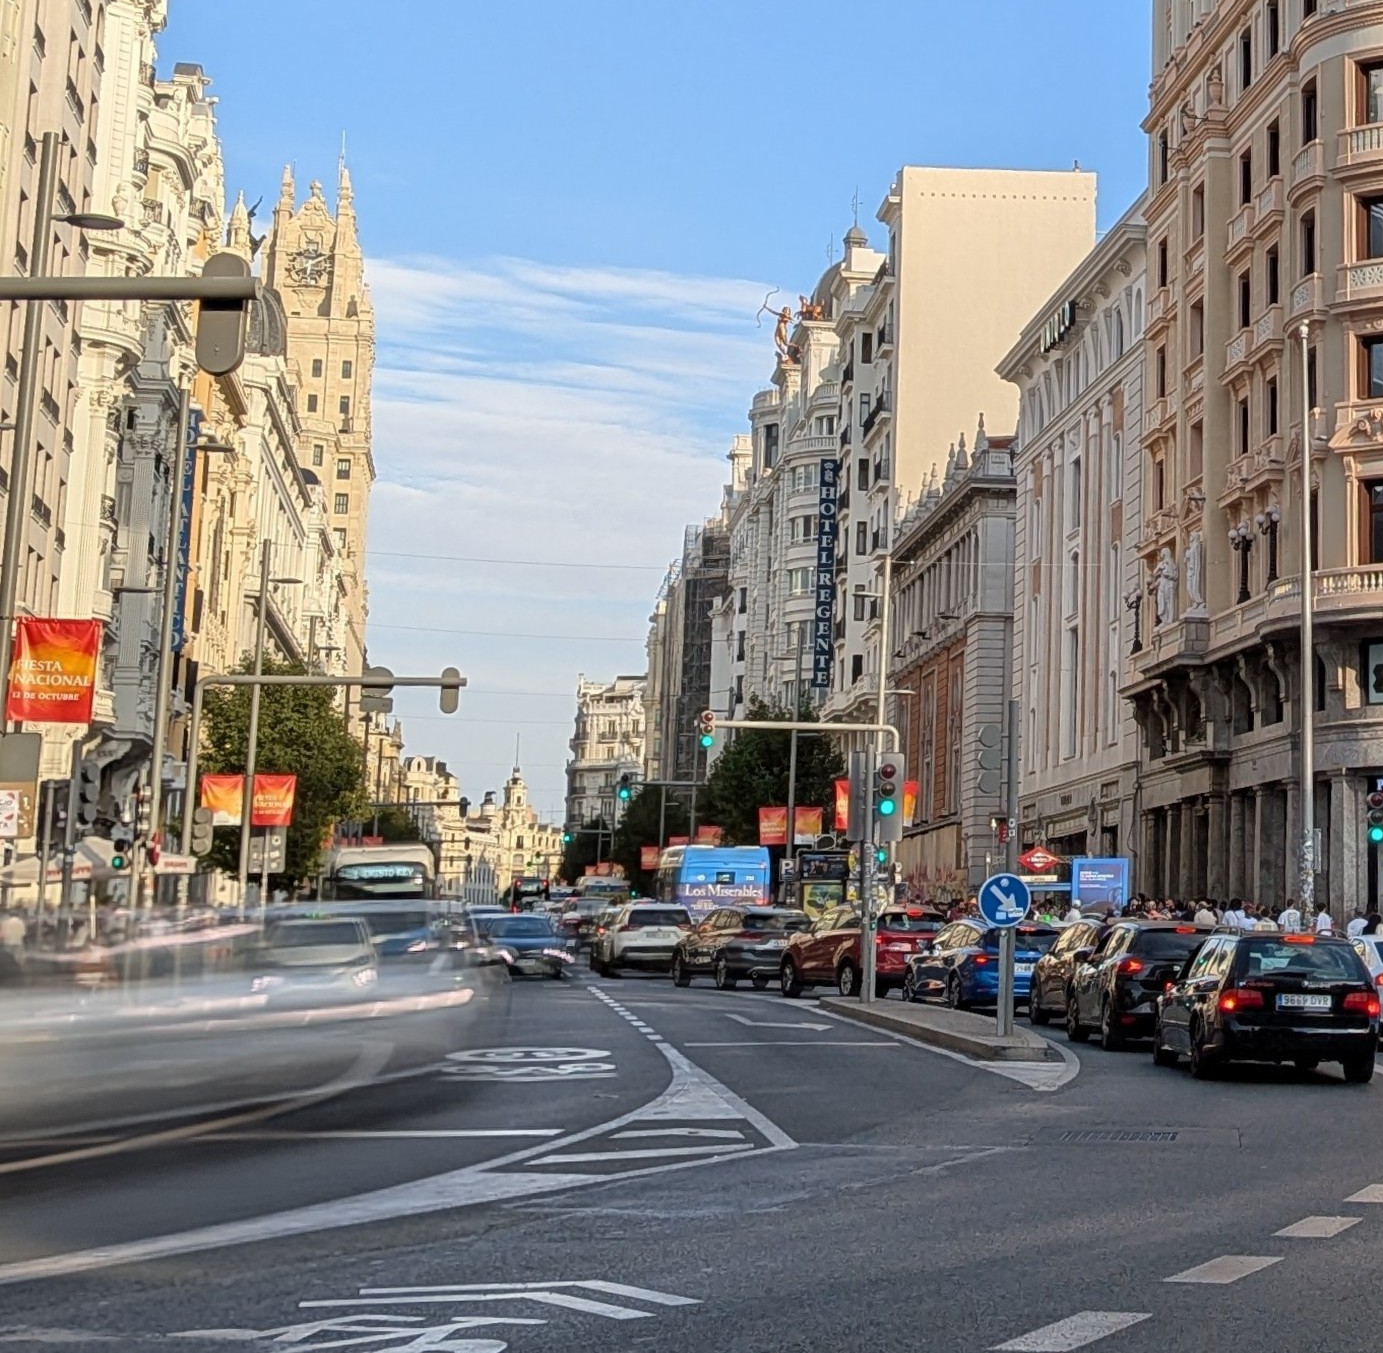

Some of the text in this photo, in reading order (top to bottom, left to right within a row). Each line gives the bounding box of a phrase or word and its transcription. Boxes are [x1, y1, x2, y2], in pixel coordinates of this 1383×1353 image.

[815, 486, 835, 684] HOTEL REGENTE
[17, 659, 62, 672] FIESTA
[14, 673, 91, 686] NACIONAL
[12, 691, 21, 699] 12
[38, 692, 80, 701] OCTUBRE
[685, 885, 707, 897] Los
